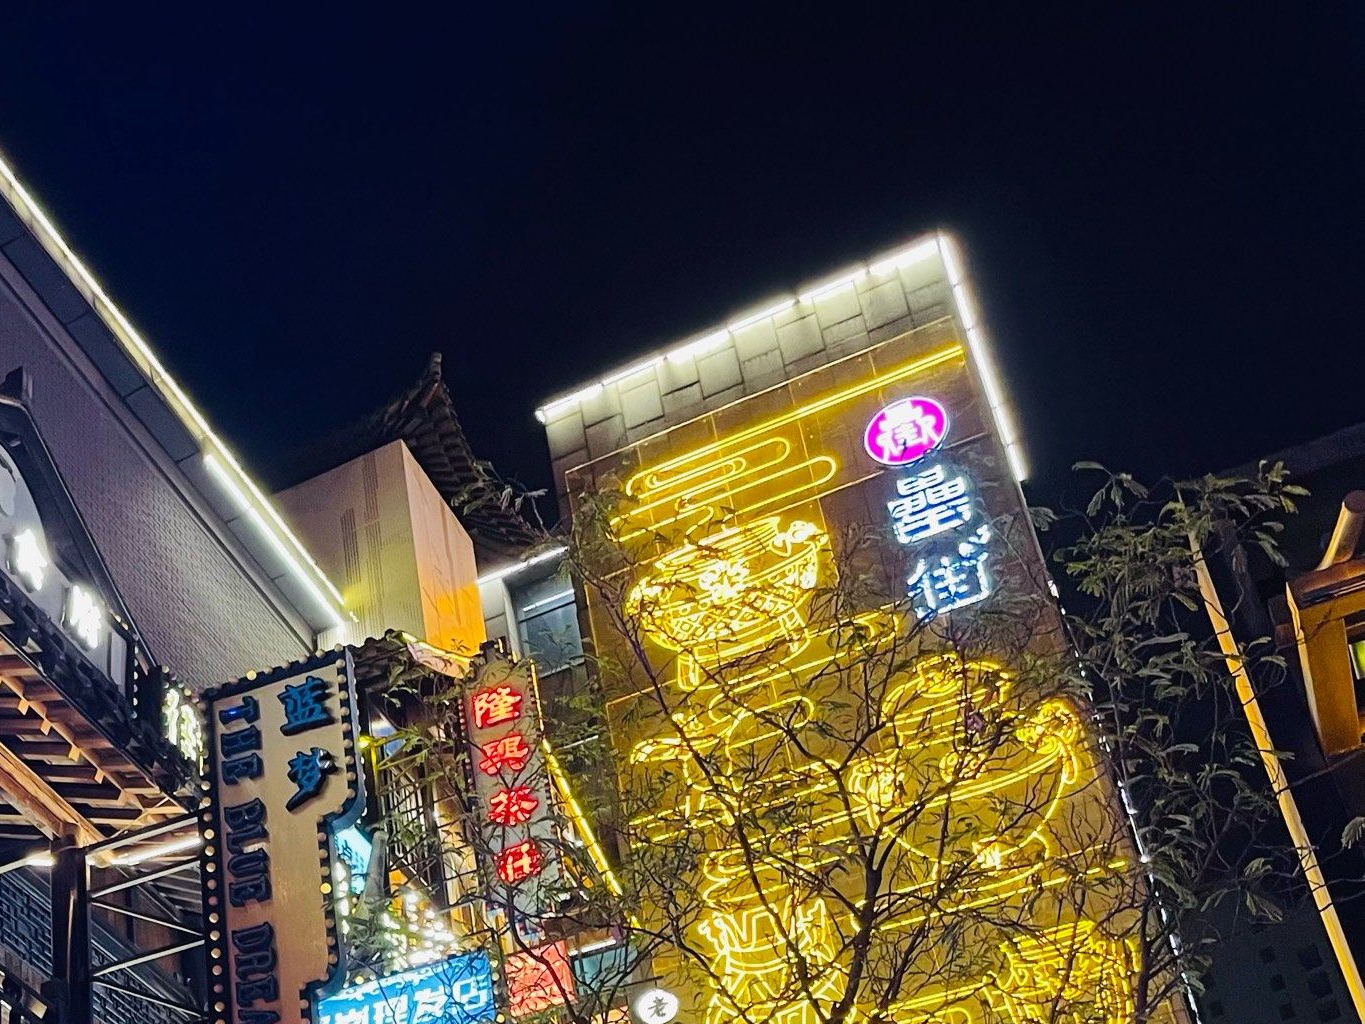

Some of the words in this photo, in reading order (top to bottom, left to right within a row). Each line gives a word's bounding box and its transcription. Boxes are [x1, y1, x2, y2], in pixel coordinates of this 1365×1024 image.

[217, 696, 264, 785] THE
[276, 676, 337, 813] 蓝梦
[223, 798, 272, 908] BLUE
